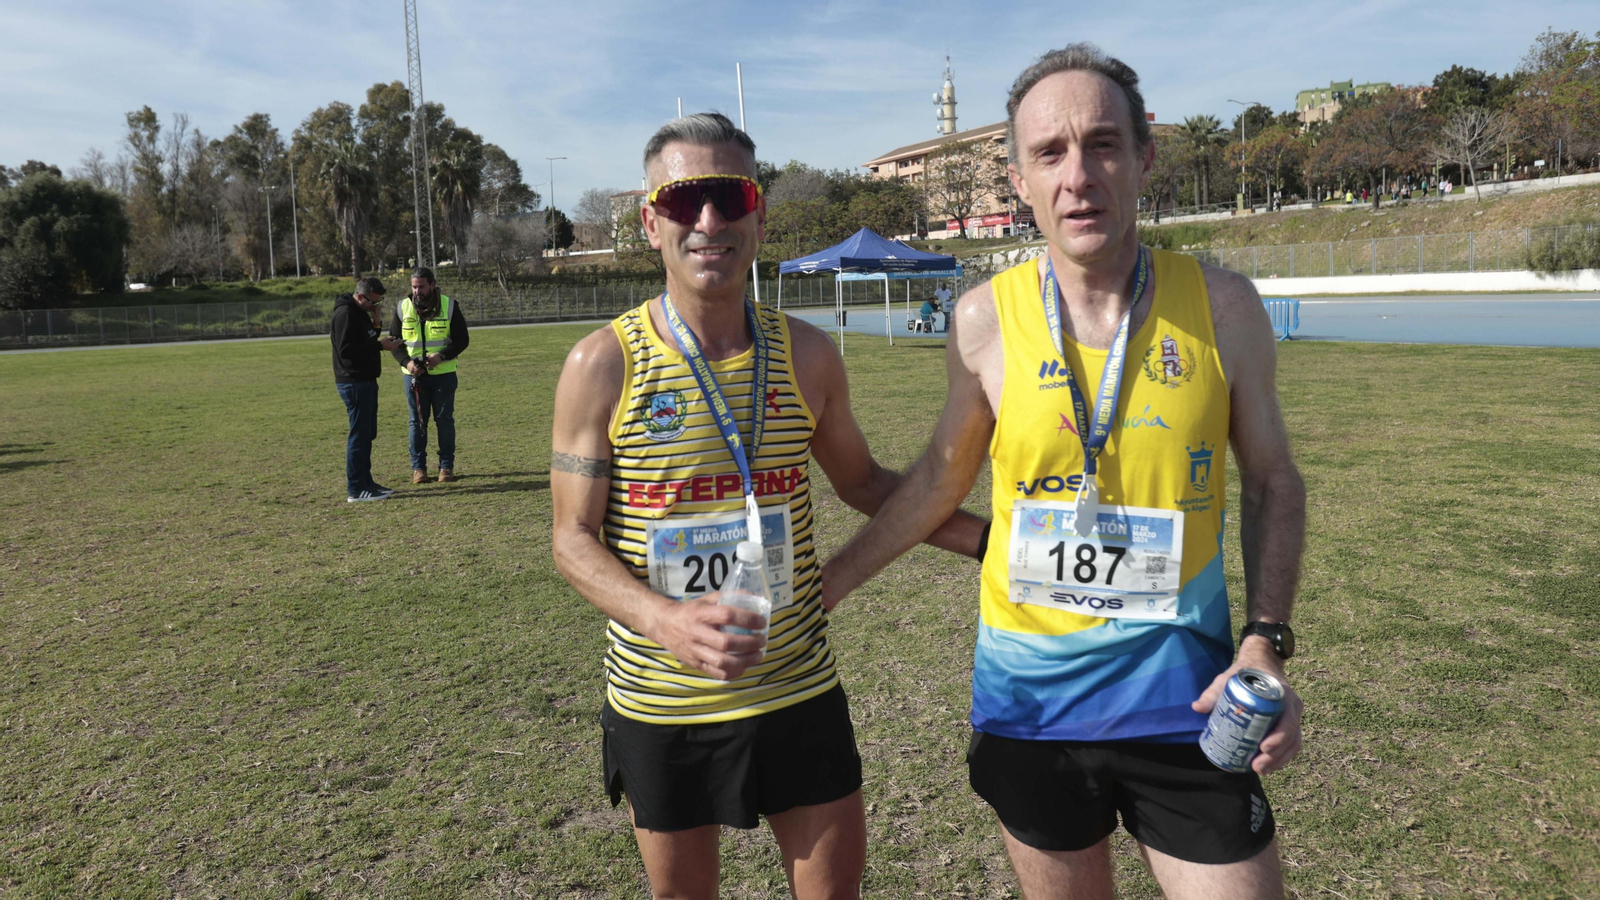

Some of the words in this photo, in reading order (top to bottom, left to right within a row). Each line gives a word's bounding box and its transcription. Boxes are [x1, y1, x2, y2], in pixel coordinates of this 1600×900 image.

[1046, 277, 1056, 315] ALGECIRAS
[676, 323, 687, 336] DE
[1048, 315, 1058, 328] DE
[681, 333, 700, 357] CIUDAD
[759, 347, 767, 358] DE
[1113, 326, 1128, 356] CIUDAD
[693, 356, 717, 392] MARATÓN
[758, 358, 766, 385] CIUDAD
[1102, 357, 1121, 397] MARATÓN
[710, 391, 728, 416] MEDIA
[756, 386, 765, 422] MARATÓN
[1074, 401, 1083, 411] 17
[1097, 398, 1113, 425] MEDIA
[753, 423, 762, 447] MEDIA
[1076, 411, 1089, 444] MARZO
[692, 525, 748, 545] MARATÓN
[1132, 530, 1157, 538] MARZO
[683, 552, 737, 593] 20
[1049, 541, 1126, 586] 187
[1151, 581, 1158, 590] S
[1050, 592, 1124, 610] EVOS
